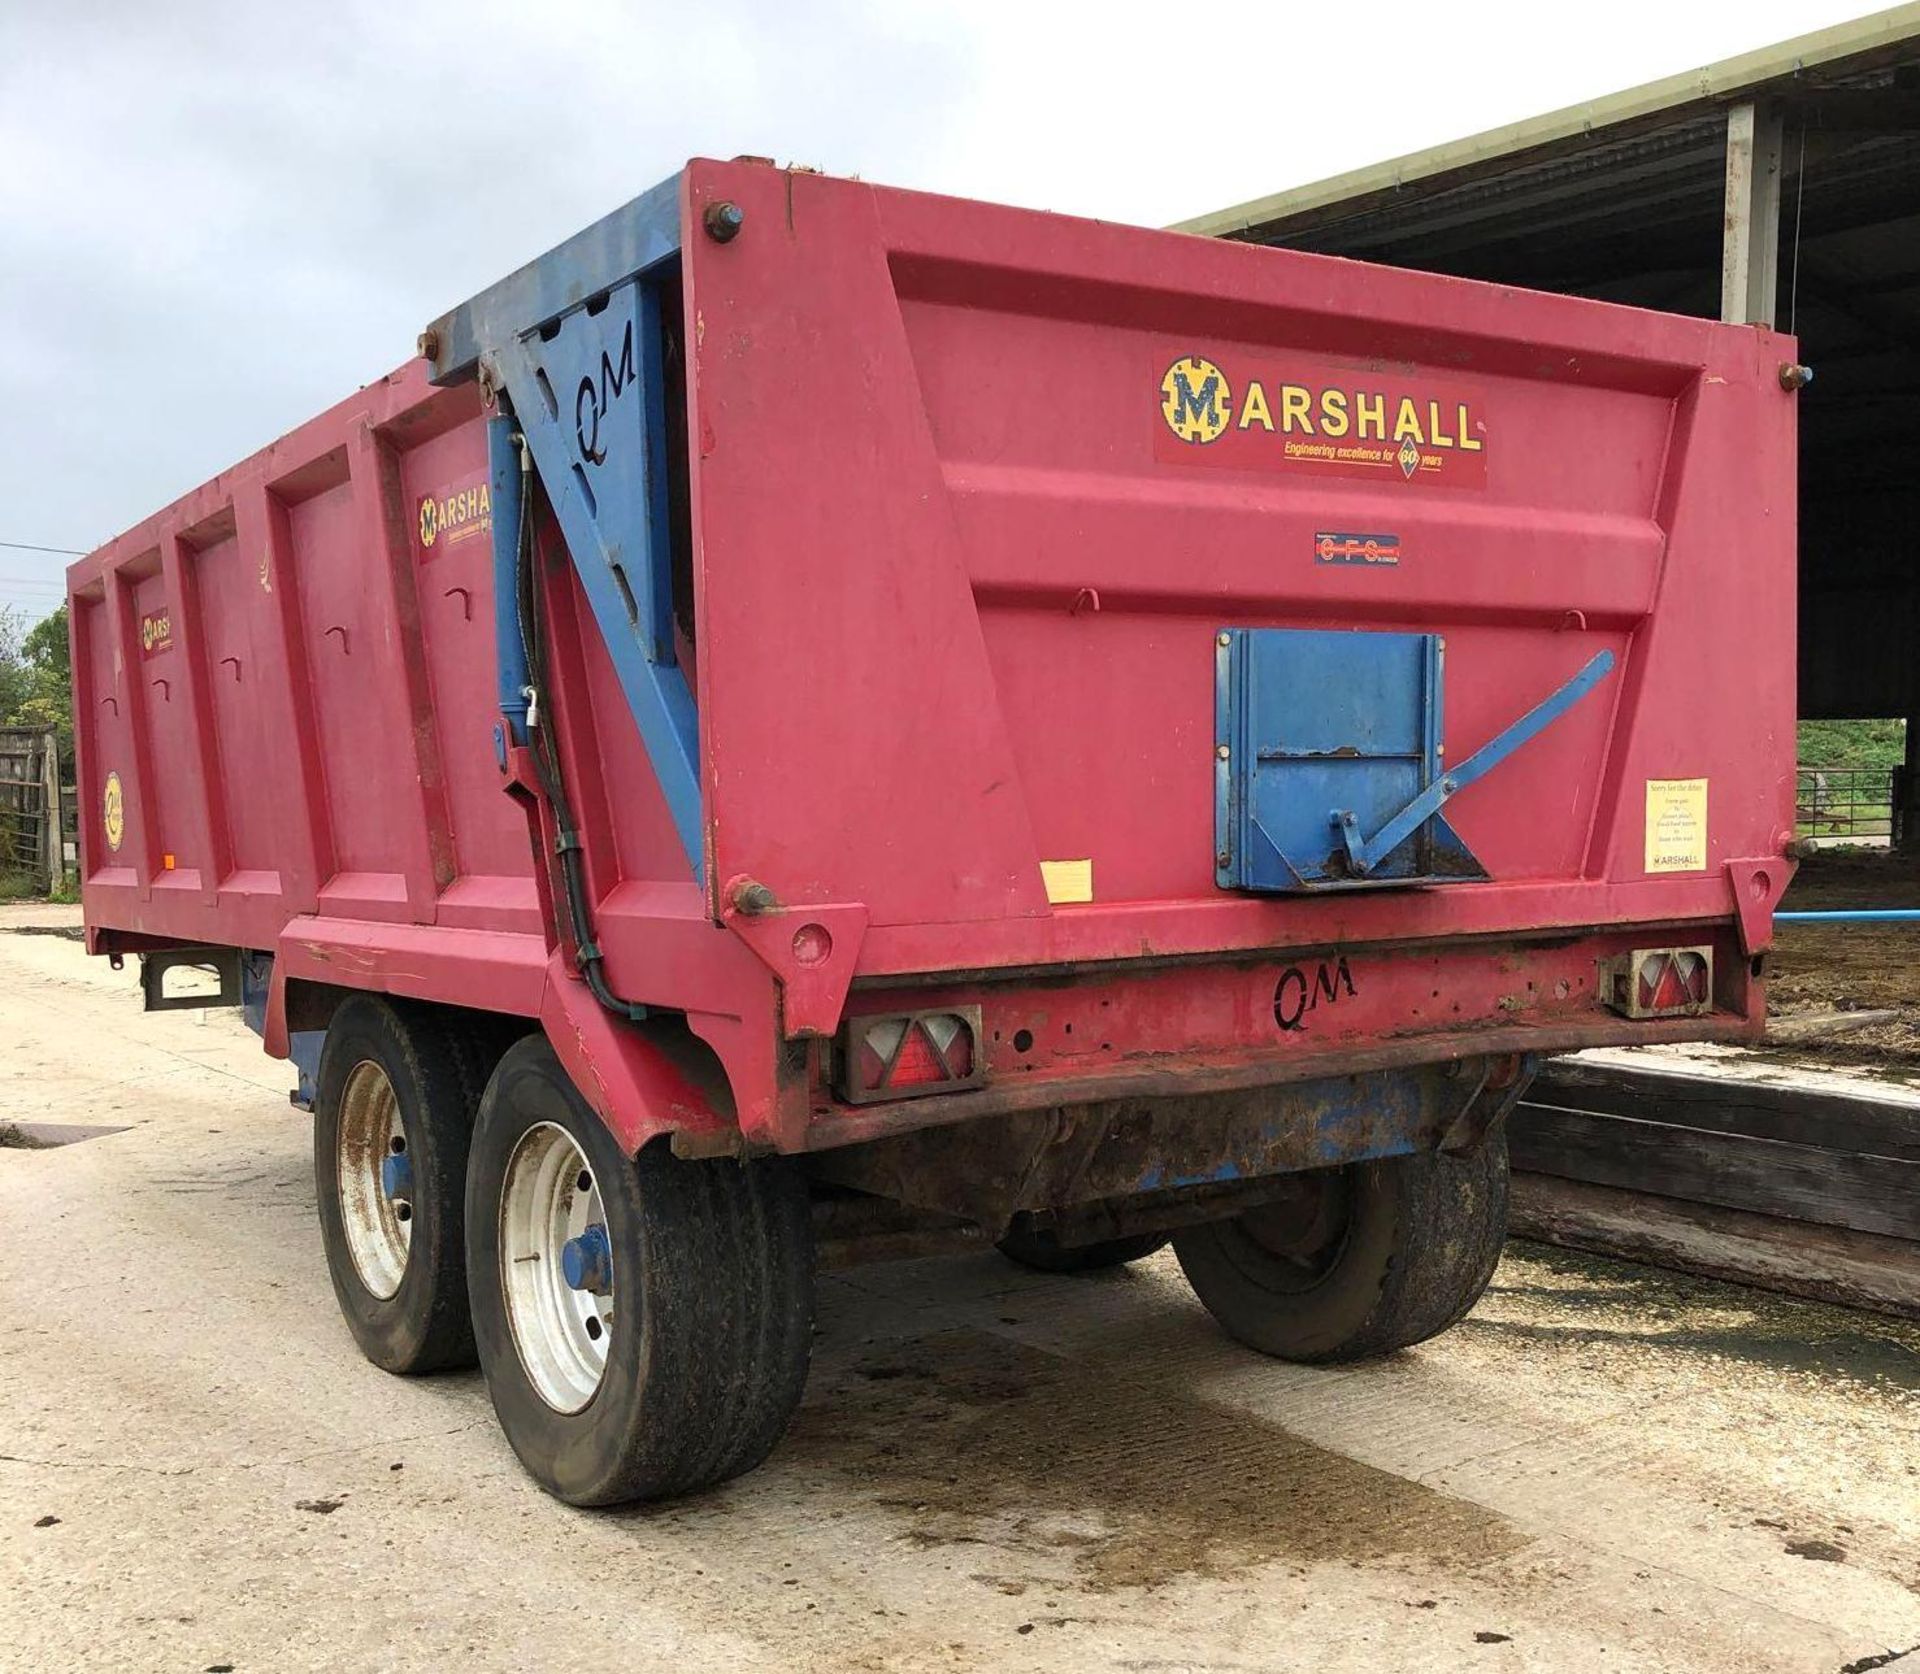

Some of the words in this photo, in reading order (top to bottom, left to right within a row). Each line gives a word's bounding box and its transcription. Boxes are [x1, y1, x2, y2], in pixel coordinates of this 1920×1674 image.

[1162, 360, 1482, 451] MARSHALL
[1284, 441, 1335, 458] Engineering
[1337, 446, 1382, 461] excellence
[1383, 449, 1395, 462] for
[1421, 454, 1443, 467] years
[421, 484, 490, 546] MARSHA
